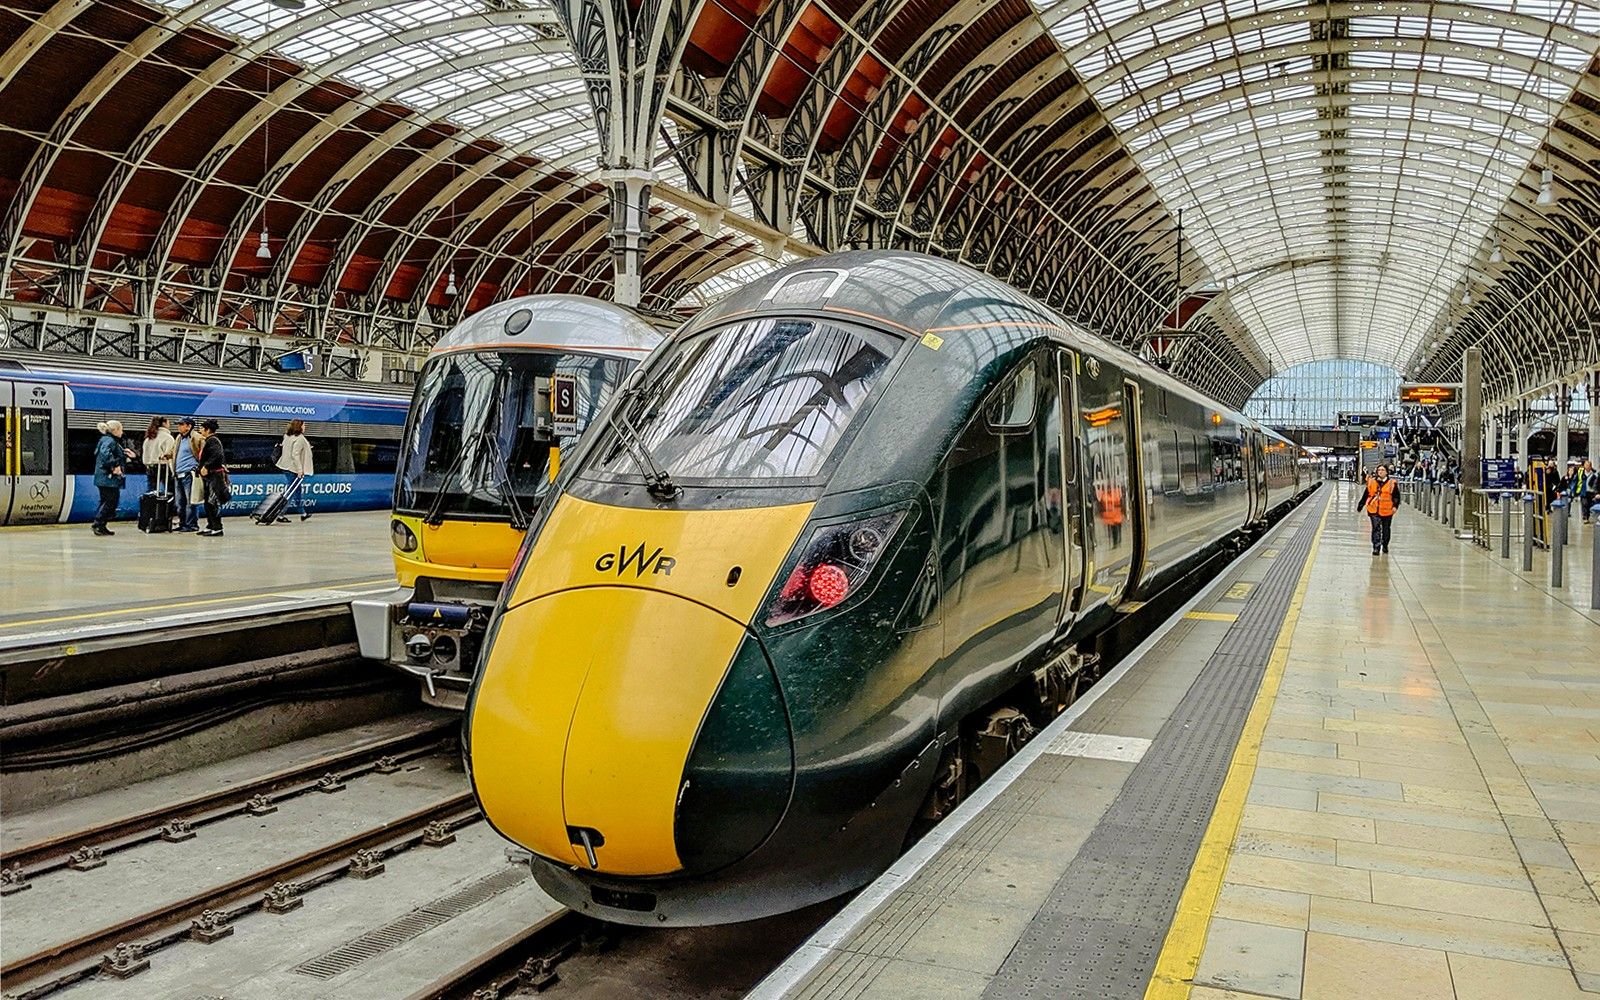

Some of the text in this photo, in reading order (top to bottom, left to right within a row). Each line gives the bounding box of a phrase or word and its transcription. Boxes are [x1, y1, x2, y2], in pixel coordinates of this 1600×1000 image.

[306, 356, 313, 373] 5
[561, 388, 570, 408] S
[241, 403, 316, 415] TATA COMMUNICATIONS
[22, 415, 30, 431] 1
[266, 483, 311, 495] BIGT
[313, 482, 352, 494] CLOUDS
[595, 541, 677, 578] GWR
